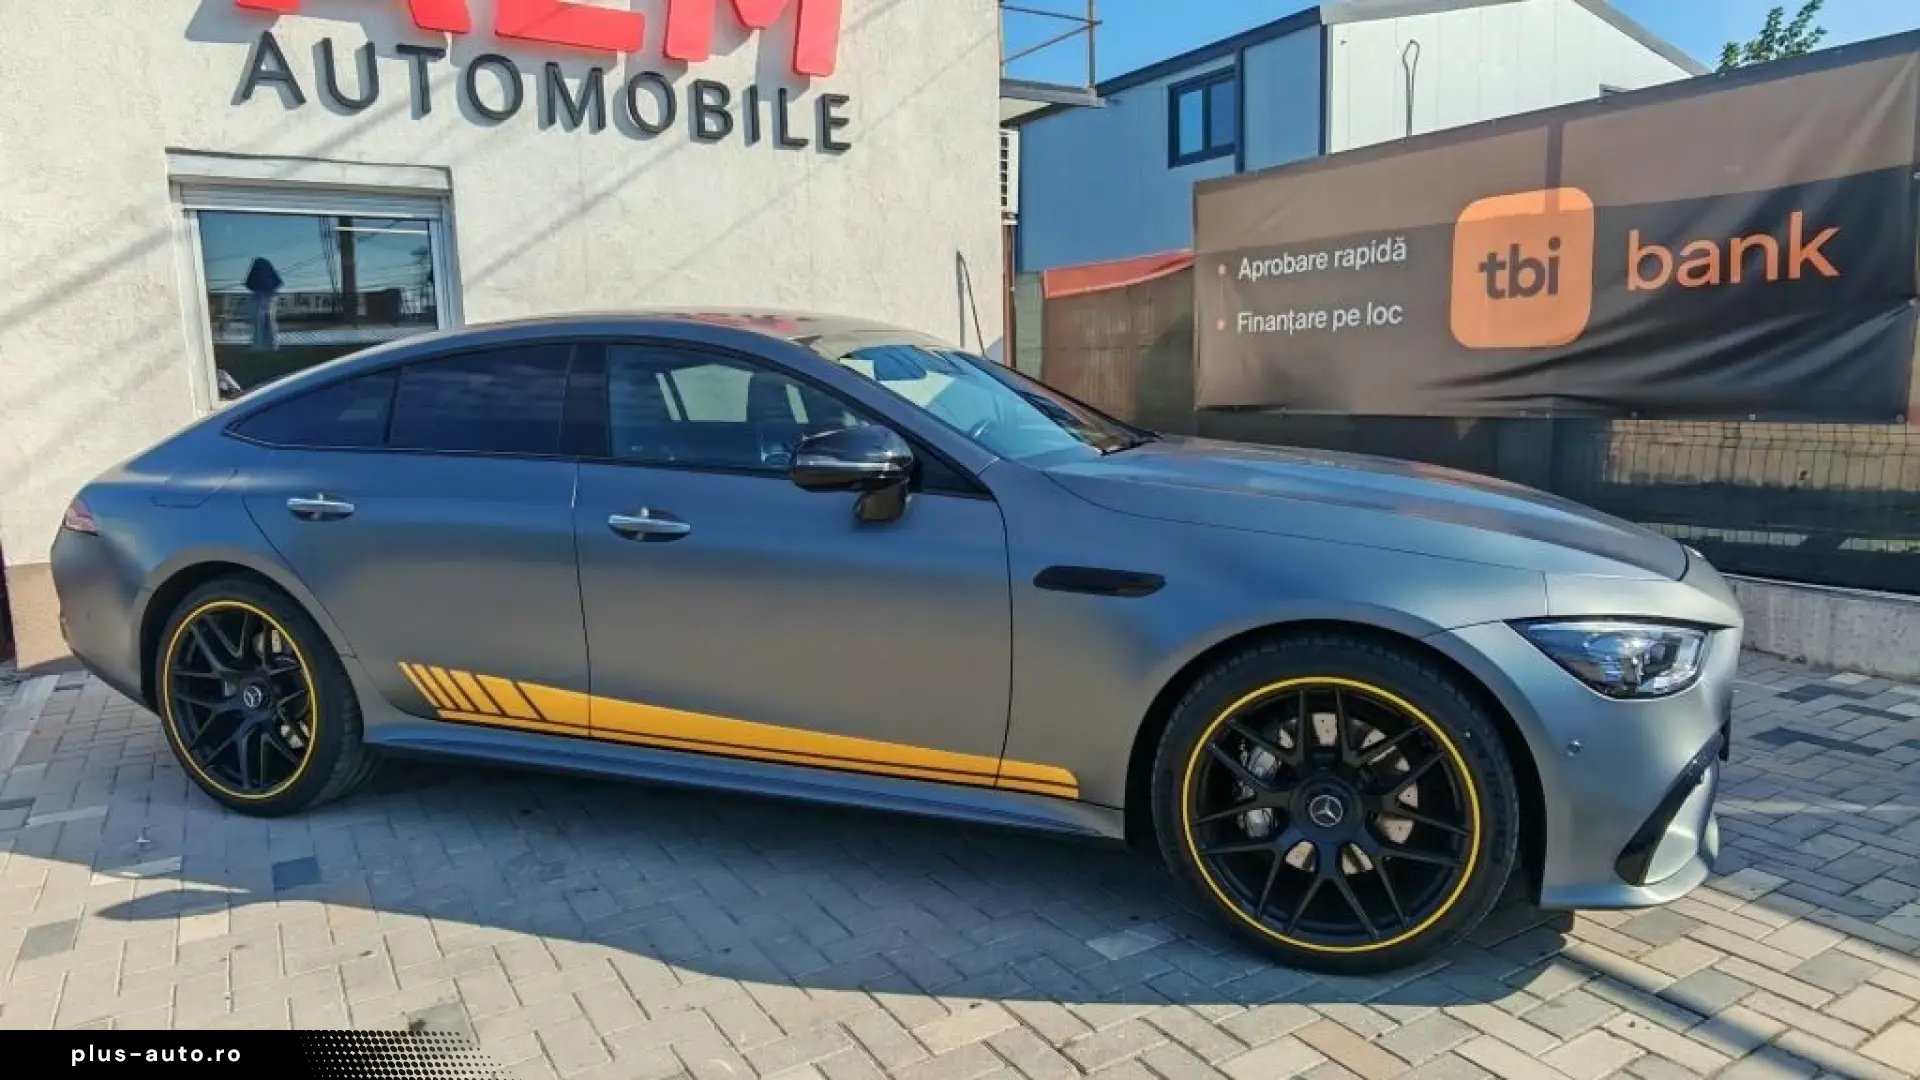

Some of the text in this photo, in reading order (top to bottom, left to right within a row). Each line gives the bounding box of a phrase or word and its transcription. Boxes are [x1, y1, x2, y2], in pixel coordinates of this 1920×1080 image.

[232, 30, 851, 152] AUTOMOBILE
[1237, 237, 1407, 281] Aprobare rapidă
[1478, 210, 1841, 300] tbi bank
[1236, 302, 1404, 337] Finanțare pe loc
